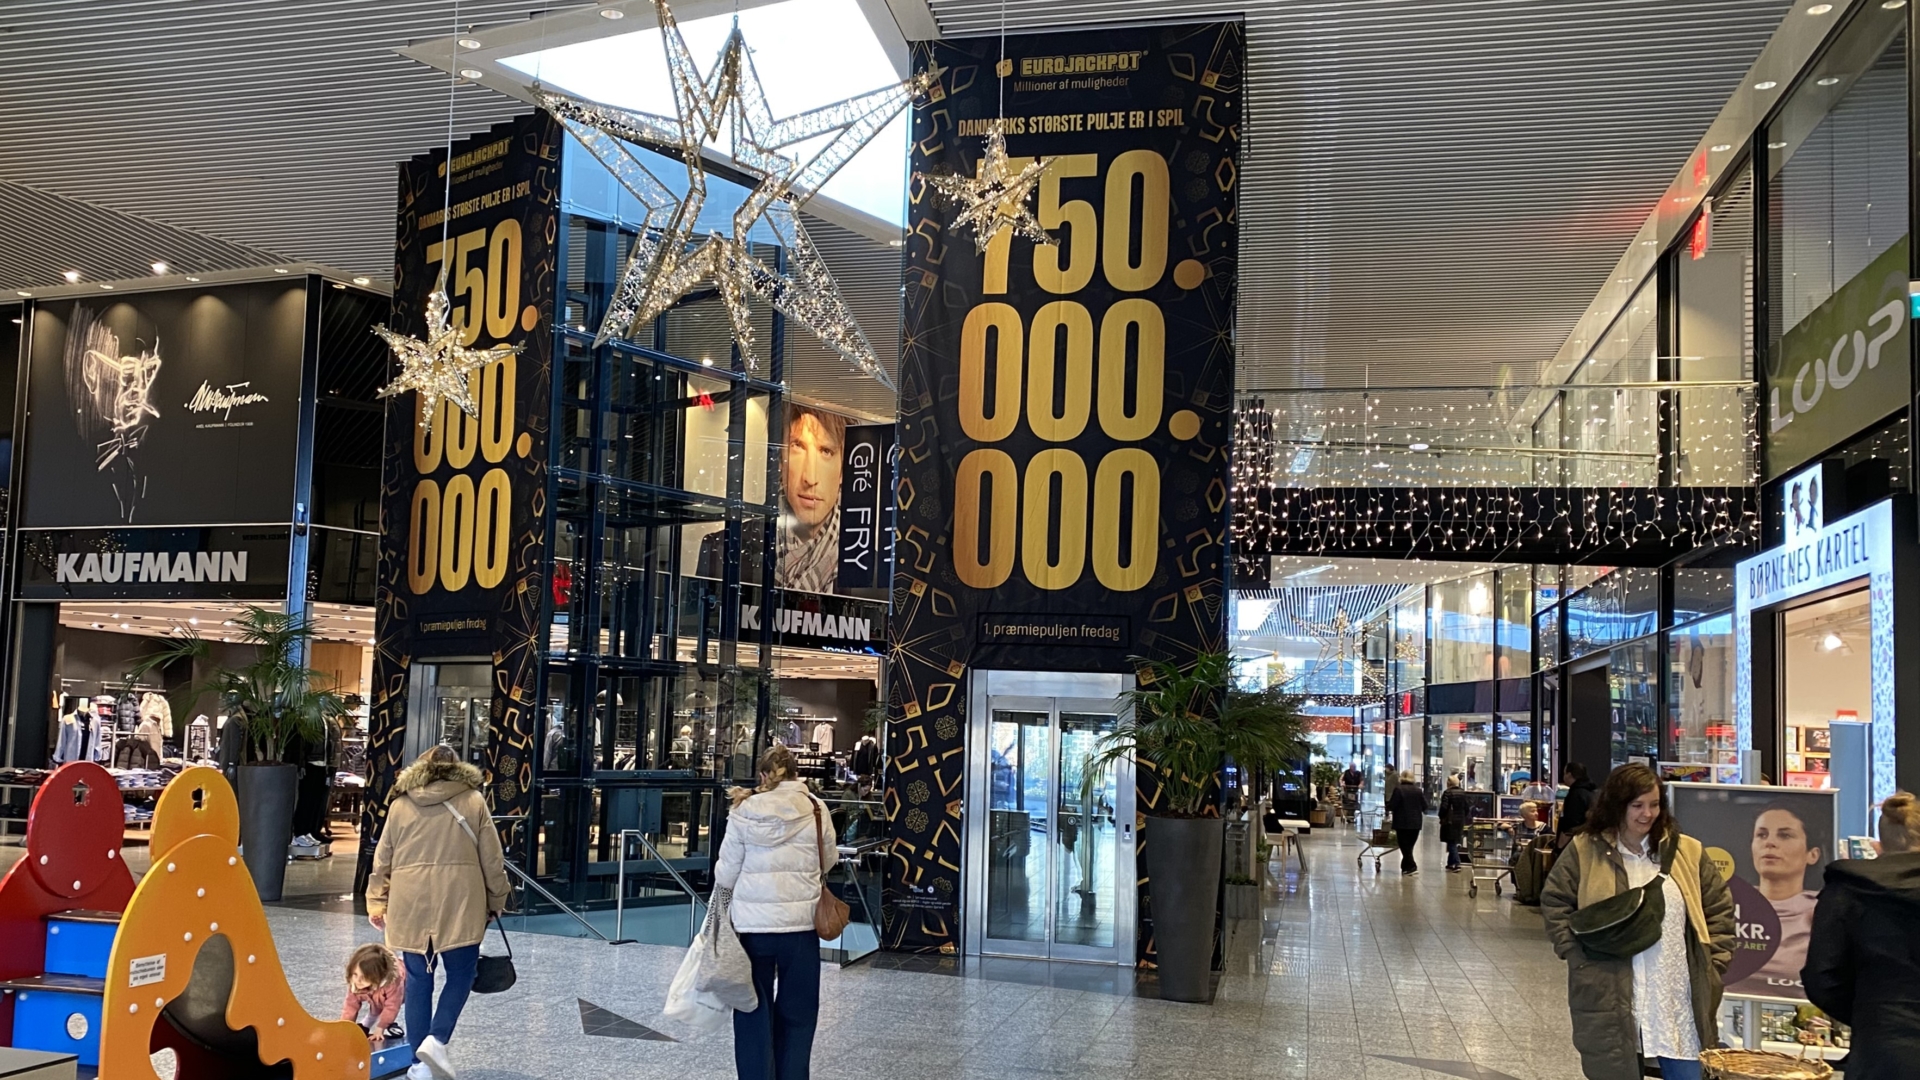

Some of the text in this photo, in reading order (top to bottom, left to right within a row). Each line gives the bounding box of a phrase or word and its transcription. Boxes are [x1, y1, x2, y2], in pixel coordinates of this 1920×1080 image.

[1020, 51, 1141, 77] EUROJACKPOT
[1013, 76, 1130, 92] Millioner af muligheder
[958, 109, 1185, 137] DANMRKS STØRSTE PULJE ER I SPIL
[481, 190, 501, 210] PULJE
[502, 187, 511, 203] ER
[516, 180, 531, 198] SPIL
[958, 298, 1201, 442] 000.
[1771, 299, 1906, 433] LOOP
[843, 441, 874, 571] Café FRY
[953, 448, 1161, 592] 000
[408, 468, 512, 595] 000
[56, 550, 248, 584] KAUFMANN
[1749, 521, 1870, 600] BØRNENES KARTEL
[741, 604, 871, 642] KUFMANN
[983, 622, 1120, 642] 1. præmiepuljen fredag
[1743, 941, 1767, 951] ÅRET
